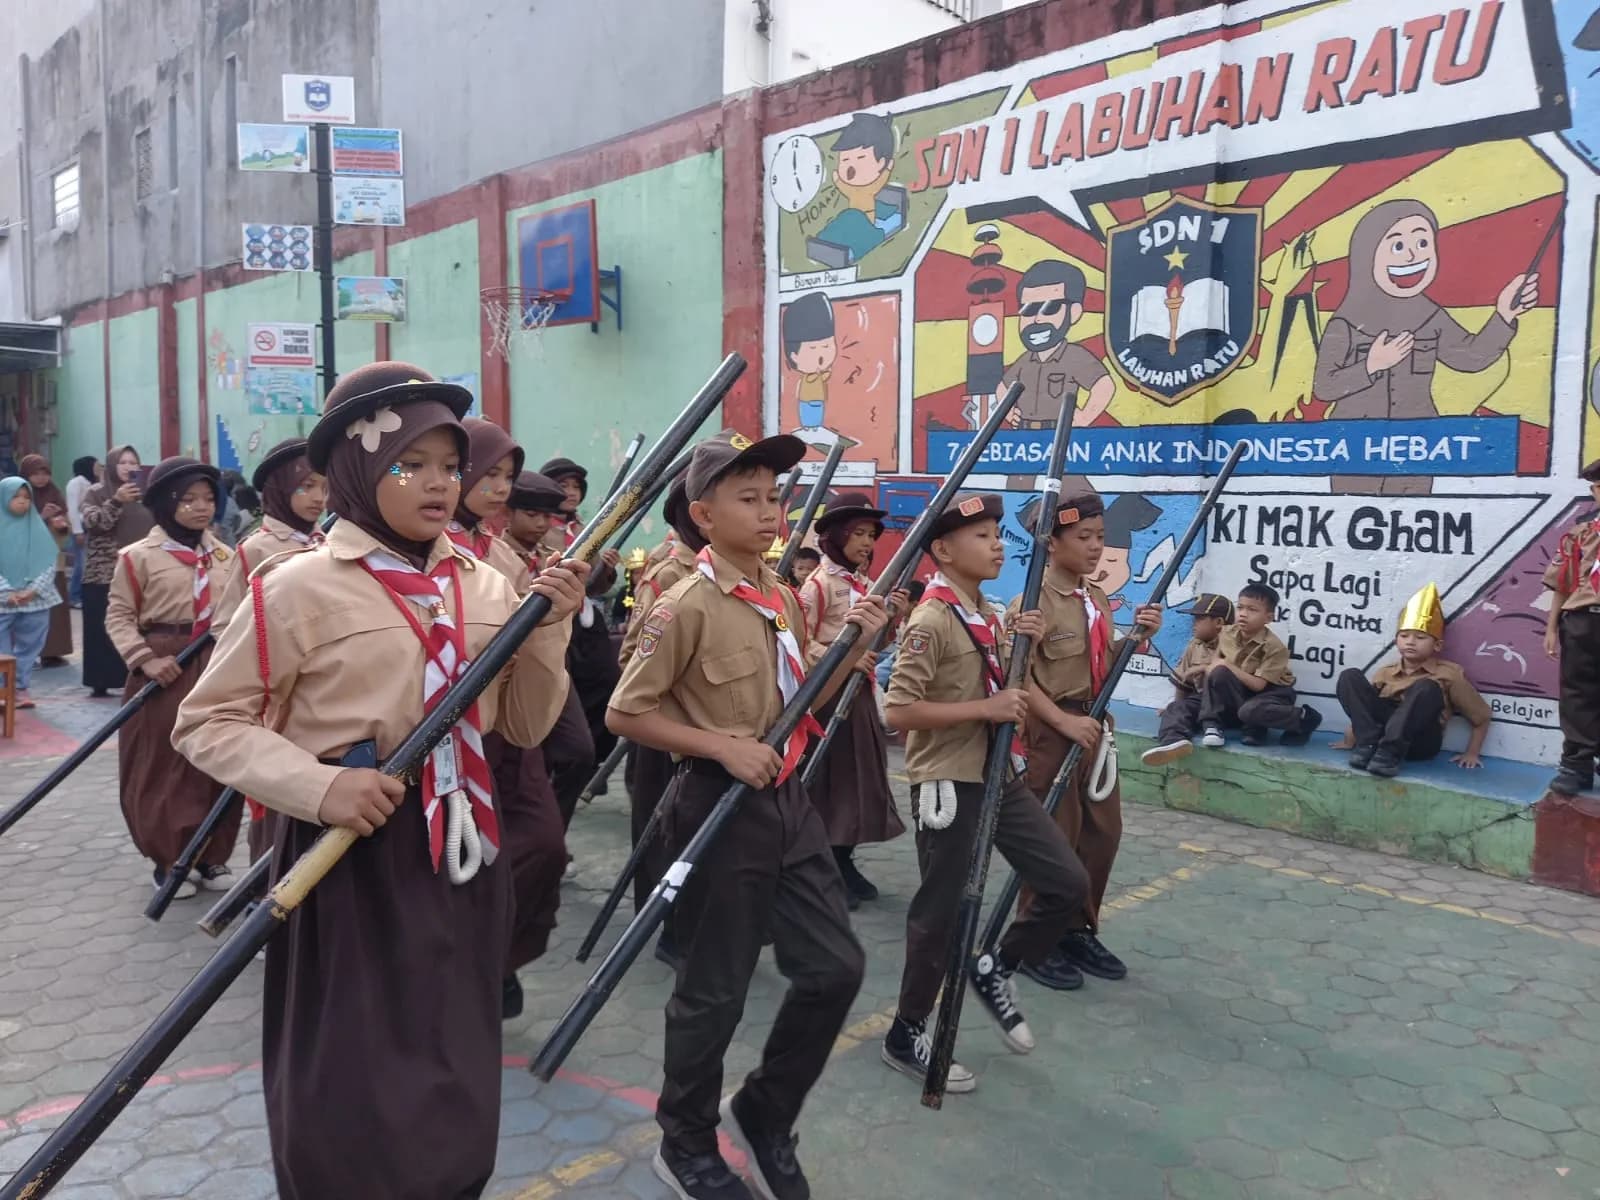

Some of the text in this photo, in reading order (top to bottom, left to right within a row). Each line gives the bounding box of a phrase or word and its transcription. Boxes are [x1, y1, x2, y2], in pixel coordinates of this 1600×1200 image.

[908, 0, 1505, 194] SDN 1 LABUHAN RATU
[1138, 215, 1230, 255] SDN 1
[1117, 339, 1240, 388] LABUHAN RATU
[947, 441, 960, 462] 7
[1100, 440, 1163, 464] ANAK
[1172, 435, 1350, 464] INDONESIA
[1364, 435, 1481, 463] HEBAT
[1247, 553, 1382, 610] Sapa Lagi
[1299, 598, 1382, 635] Ganta
[1287, 634, 1346, 680] Lagi
[1490, 698, 1554, 722] Belajar
